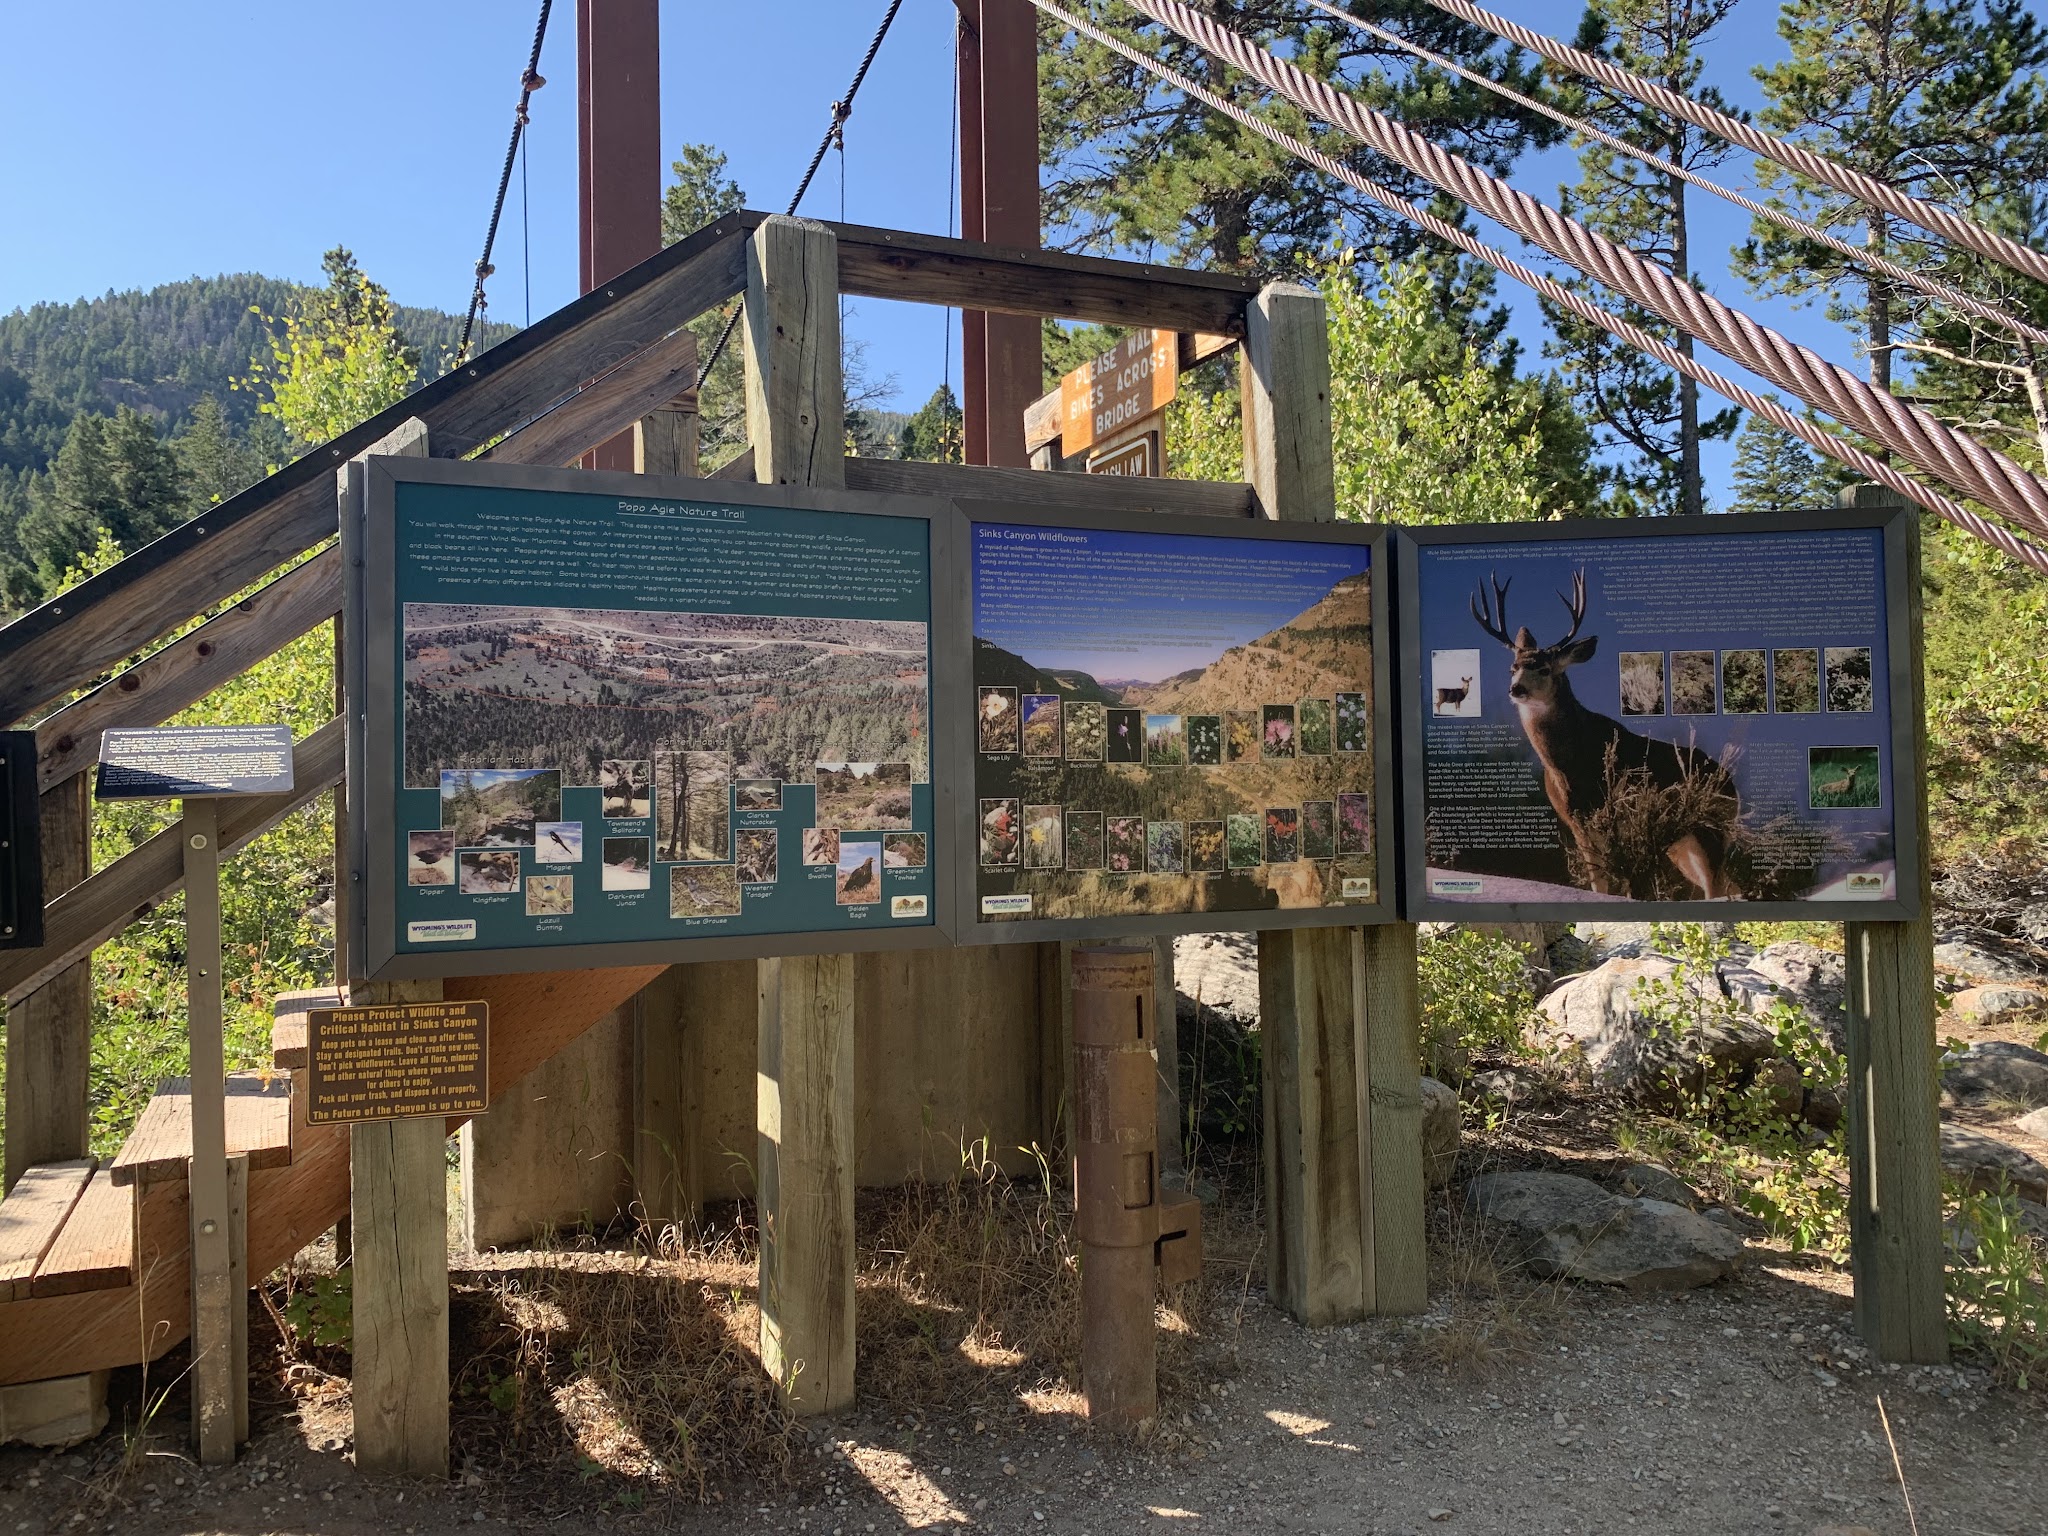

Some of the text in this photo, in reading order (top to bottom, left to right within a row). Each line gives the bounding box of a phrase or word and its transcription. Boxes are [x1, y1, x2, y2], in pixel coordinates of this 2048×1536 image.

[1076, 348, 1116, 389] PLEASE
[1070, 347, 1166, 420] BIKES ACROSS
[1096, 392, 1140, 434] BRIDGE
[619, 502, 744, 518] Popo Agie Nature Trail
[979, 528, 1088, 543] Sinks Canyon Wildflowers
[332, 1006, 465, 1022] Please Protect Wildlife and
[320, 1018, 476, 1034] Critical Habitat in Sinks Canyon
[321, 1040, 338, 1049] Keep
[340, 1038, 355, 1048] pets
[394, 1036, 406, 1044] and
[408, 1035, 426, 1043] clean
[439, 1033, 455, 1042] after
[458, 1032, 475, 1040] them.
[316, 1051, 331, 1060] Stay
[344, 1048, 381, 1060] designated
[383, 1046, 403, 1056] trails.
[406, 1046, 422, 1054] Don't
[424, 1044, 446, 1053] create
[318, 1062, 336, 1071] Don't
[338, 1060, 352, 1070] pick
[355, 1058, 396, 1068] wildflowers.
[398, 1056, 417, 1065] Leave
[430, 1054, 448, 1063] flora,
[450, 1053, 478, 1062] minerals
[322, 1072, 335, 1081] and
[337, 1071, 356, 1080] other
[358, 1068, 382, 1078] natural
[384, 1068, 404, 1078] things
[407, 1066, 428, 1075] where
[458, 1064, 474, 1072] them
[366, 1077, 432, 1088] for others to enjoy.
[318, 1094, 334, 1103] Pack
[337, 1092, 348, 1102] out
[350, 1094, 366, 1102] your
[368, 1090, 388, 1099] trash,
[390, 1090, 402, 1098] and
[404, 1088, 429, 1097] dispose
[312, 1110, 328, 1120] The
[332, 1108, 360, 1118] Future
[364, 1106, 373, 1115] of
[376, 1105, 390, 1114] the
[394, 1104, 426, 1114] Canyon
[428, 1102, 436, 1110] is
[440, 1102, 450, 1110] up
[466, 1100, 482, 1108] you.
